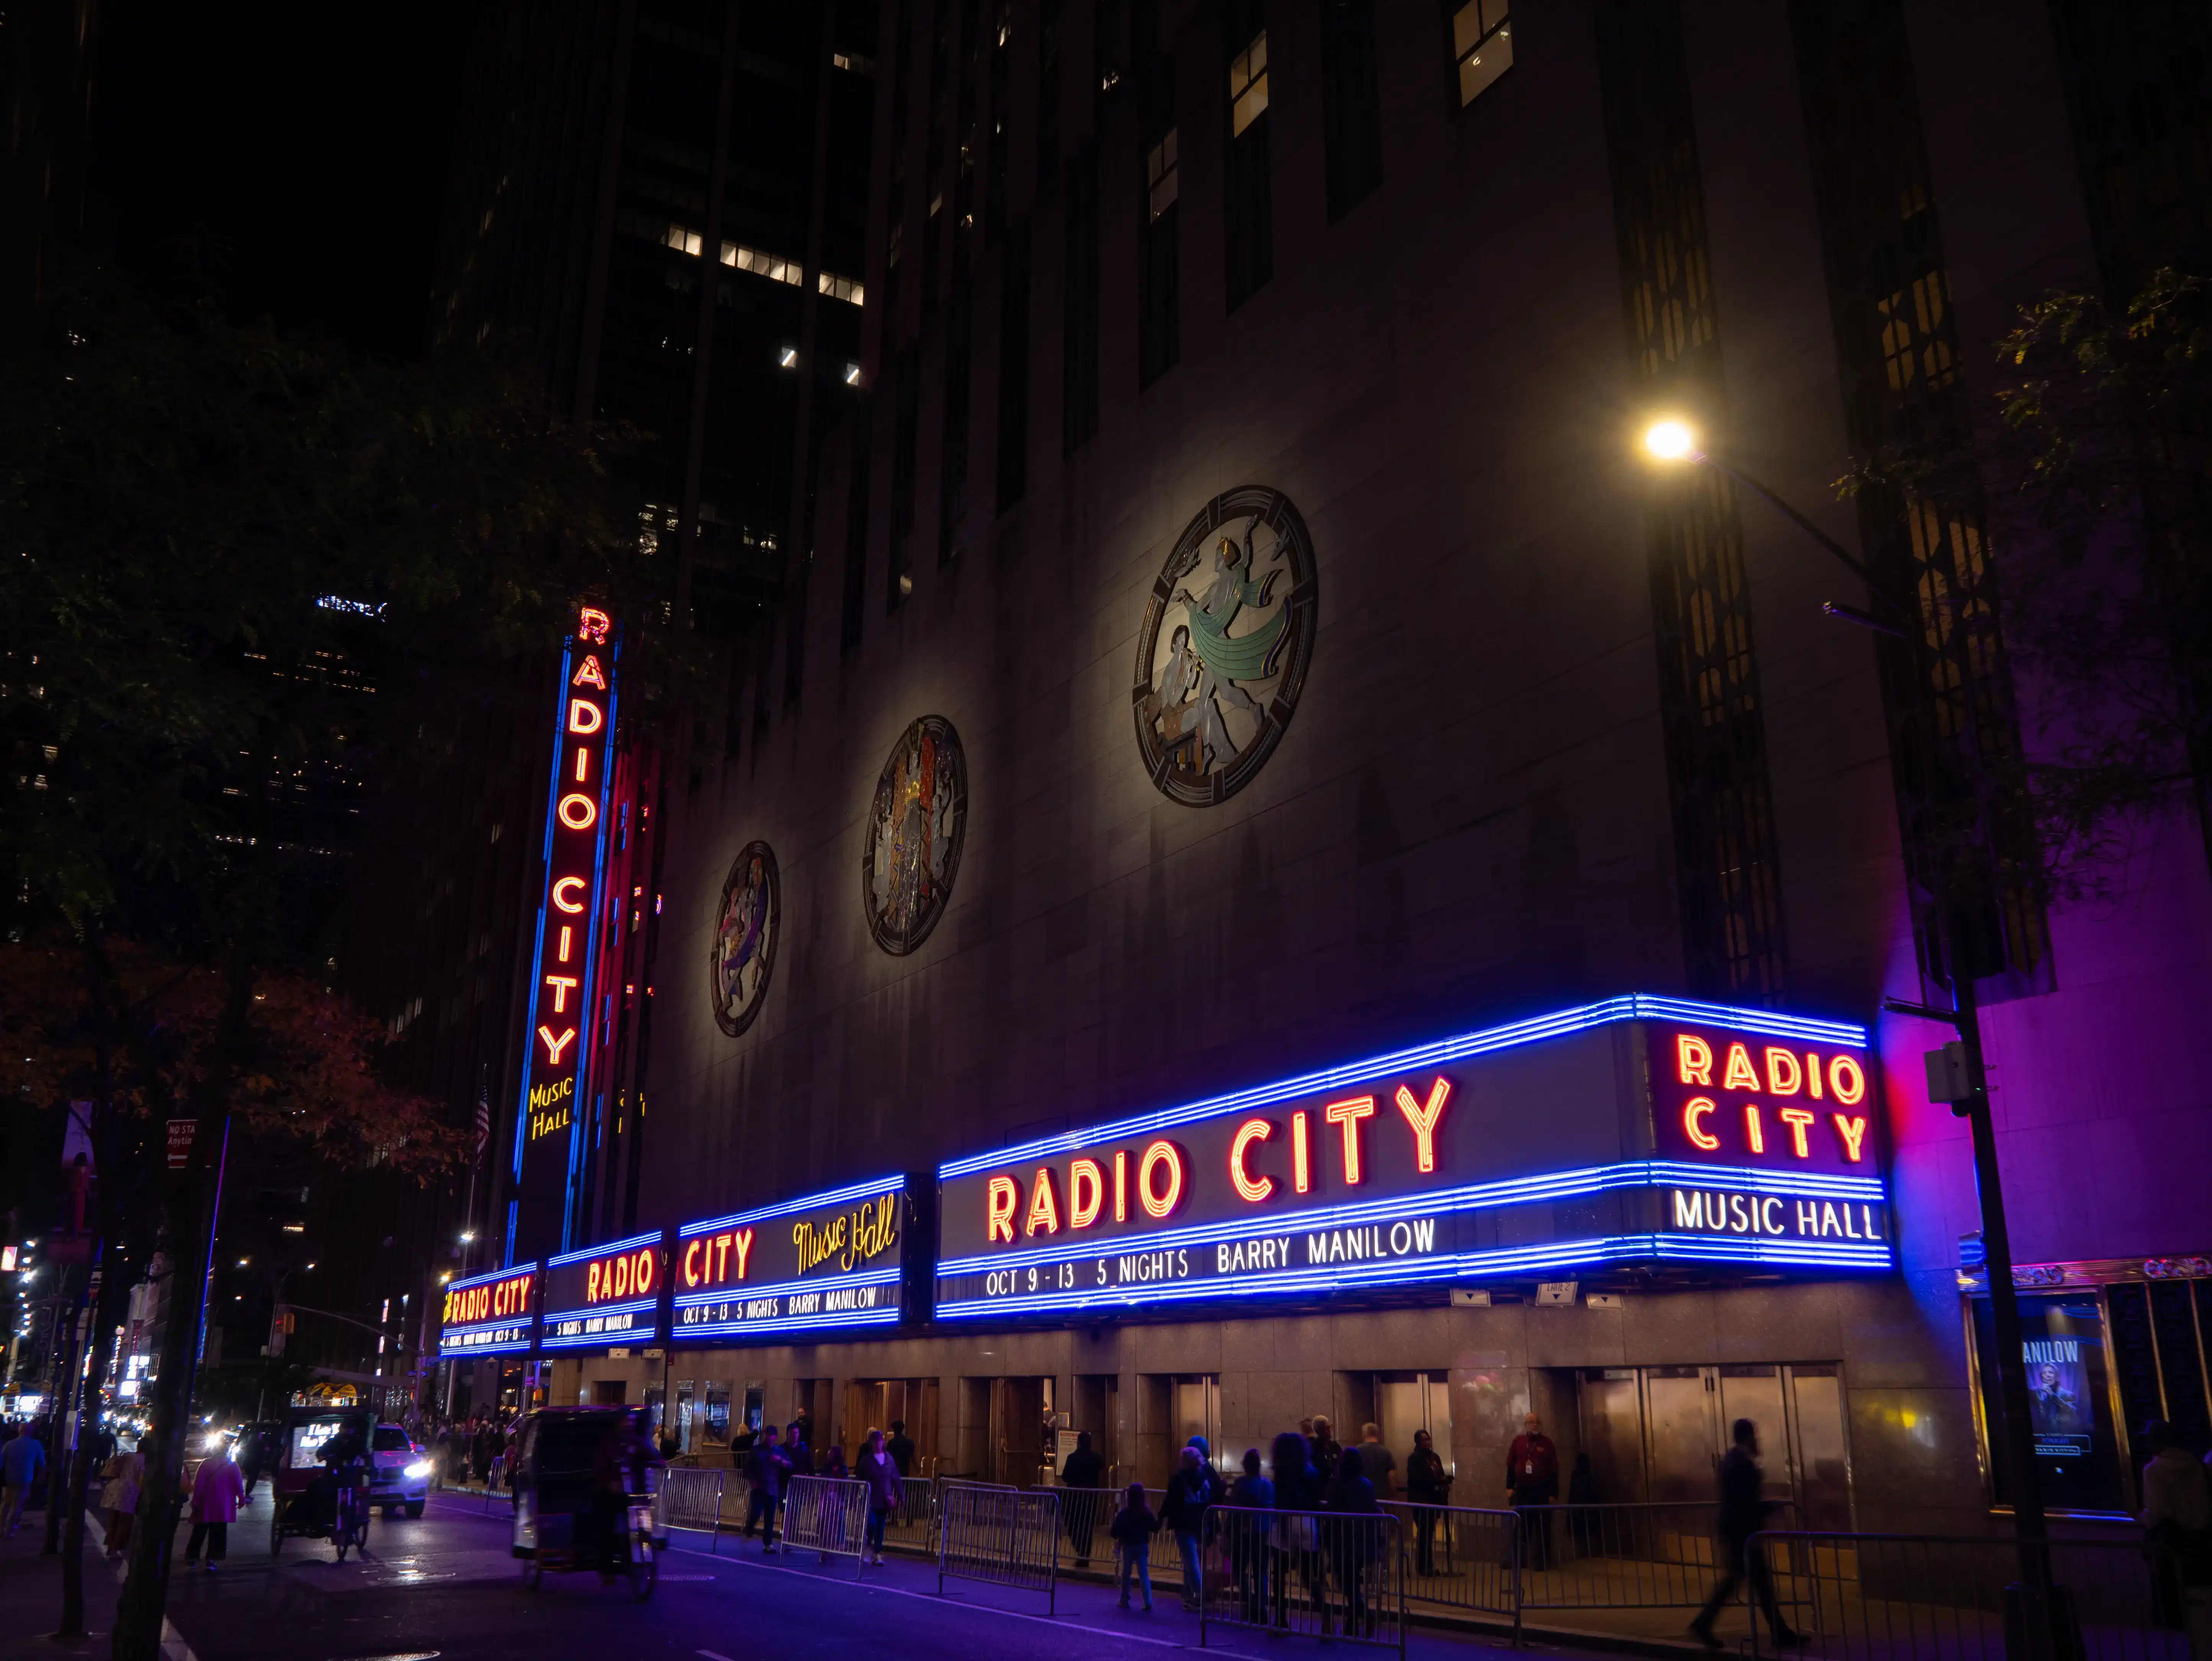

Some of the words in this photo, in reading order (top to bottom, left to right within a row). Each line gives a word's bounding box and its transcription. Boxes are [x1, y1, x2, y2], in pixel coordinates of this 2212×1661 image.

[559, 607, 610, 830] RADIO
[539, 876, 586, 1065] CITY
[1677, 1034, 1865, 1105] RADIO
[168, 1125, 179, 1134] NO
[1684, 1096, 1866, 1162] CITY
[988, 1139, 1182, 1243] RADIO
[1230, 1076, 1450, 1202] CITY
[794, 1216, 846, 1275] Music
[841, 1192, 894, 1271] Hall
[1674, 1189, 1785, 1235] MUSIC
[1796, 1200, 1882, 1240] HALL
[587, 1250, 653, 1303] RADIO
[685, 1227, 752, 1287] CITY
[987, 1270, 1017, 1296] OCT
[1028, 1267, 1037, 1291] 9
[1059, 1263, 1073, 1289] 13
[1097, 1259, 1106, 1285] 5
[1119, 1249, 1188, 1283] NIGHTS
[1217, 1237, 1290, 1273] BARRY
[1308, 1218, 1434, 1264] MANILOW
[452, 1286, 489, 1324] RADIO
[494, 1276, 530, 1316] CITY
[557, 1322, 561, 1336] 5
[605, 1314, 633, 1331] MANILOW
[683, 1306, 699, 1324] OCT
[703, 1306, 709, 1322] 9
[719, 1303, 728, 1320] 13
[737, 1302, 743, 1319] 5
[747, 1298, 778, 1320] NIGHTS
[789, 1293, 820, 1315] BARRY
[826, 1287, 876, 1311] MANILOW
[2022, 1340, 2078, 1363] ANILOW
